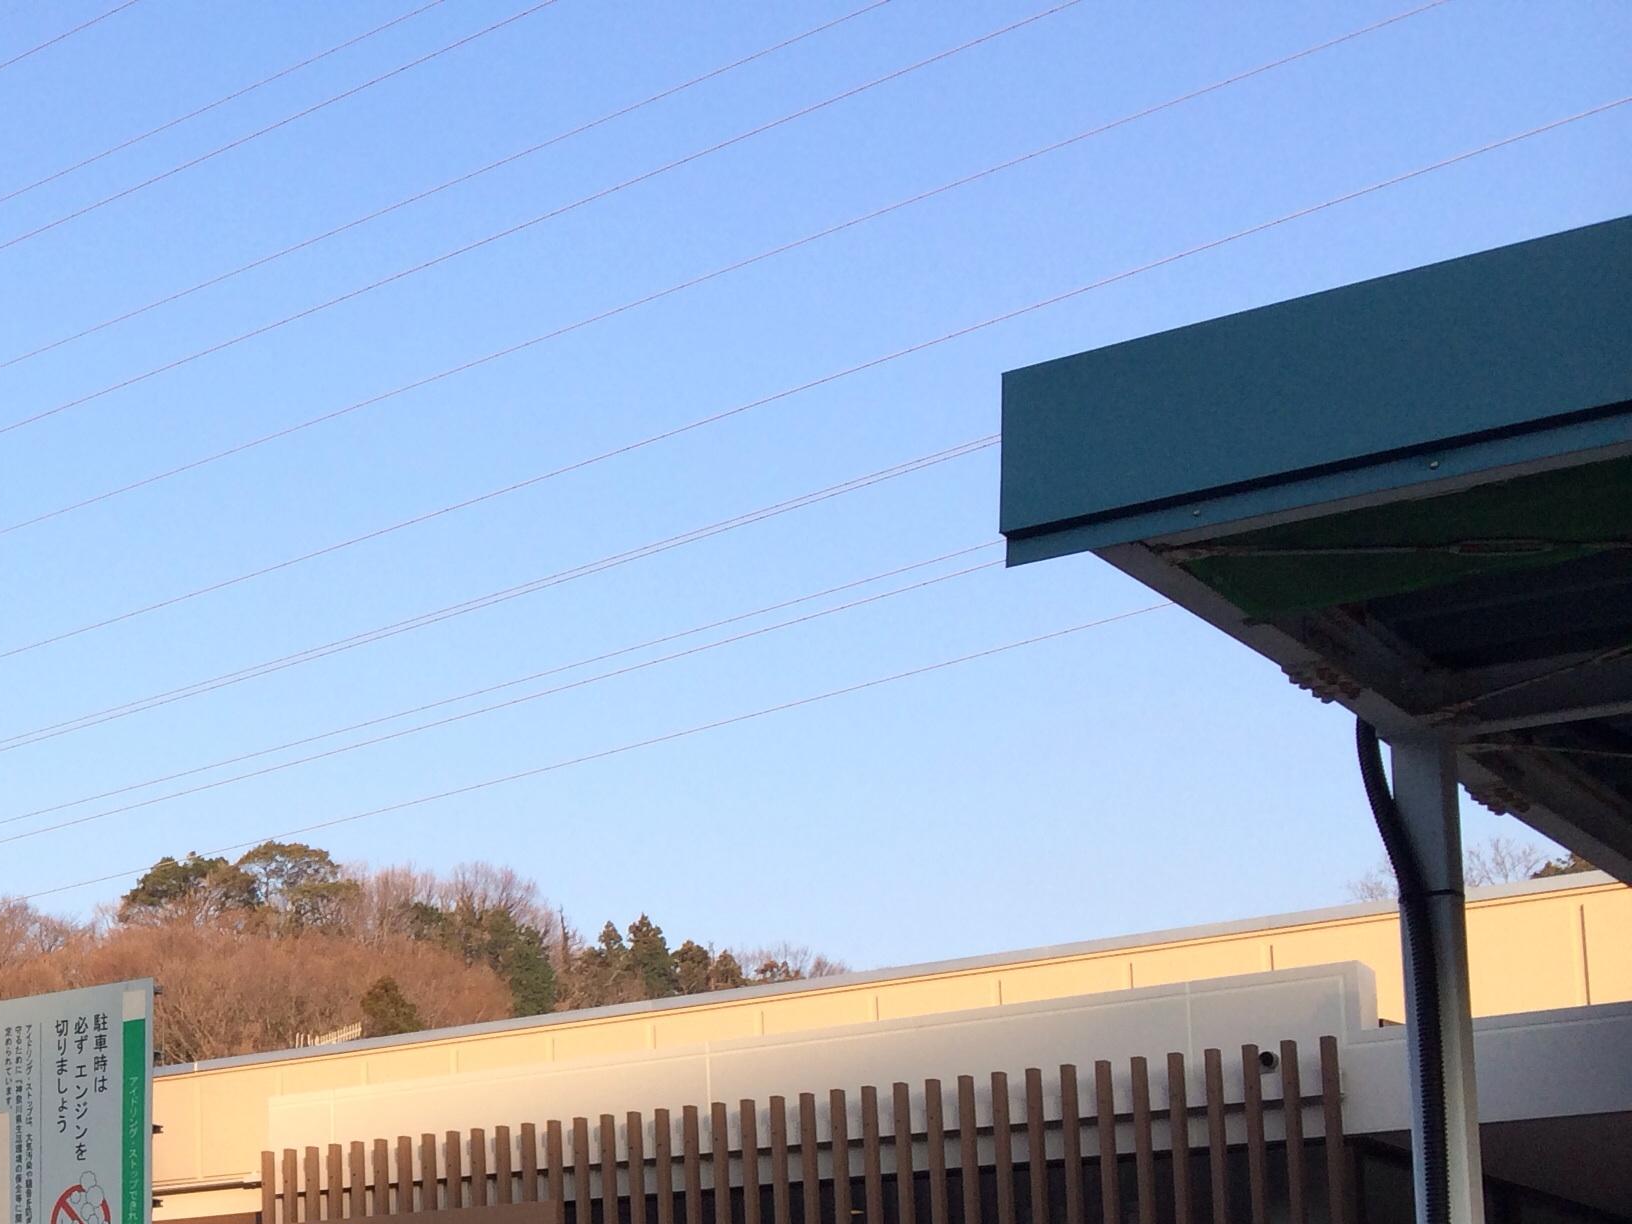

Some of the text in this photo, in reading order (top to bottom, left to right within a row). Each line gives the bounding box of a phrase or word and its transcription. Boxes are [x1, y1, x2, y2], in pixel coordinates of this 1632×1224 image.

[55, 1019, 69, 1133] 切りましょう
[93, 1013, 109, 1093] 駐車時は
